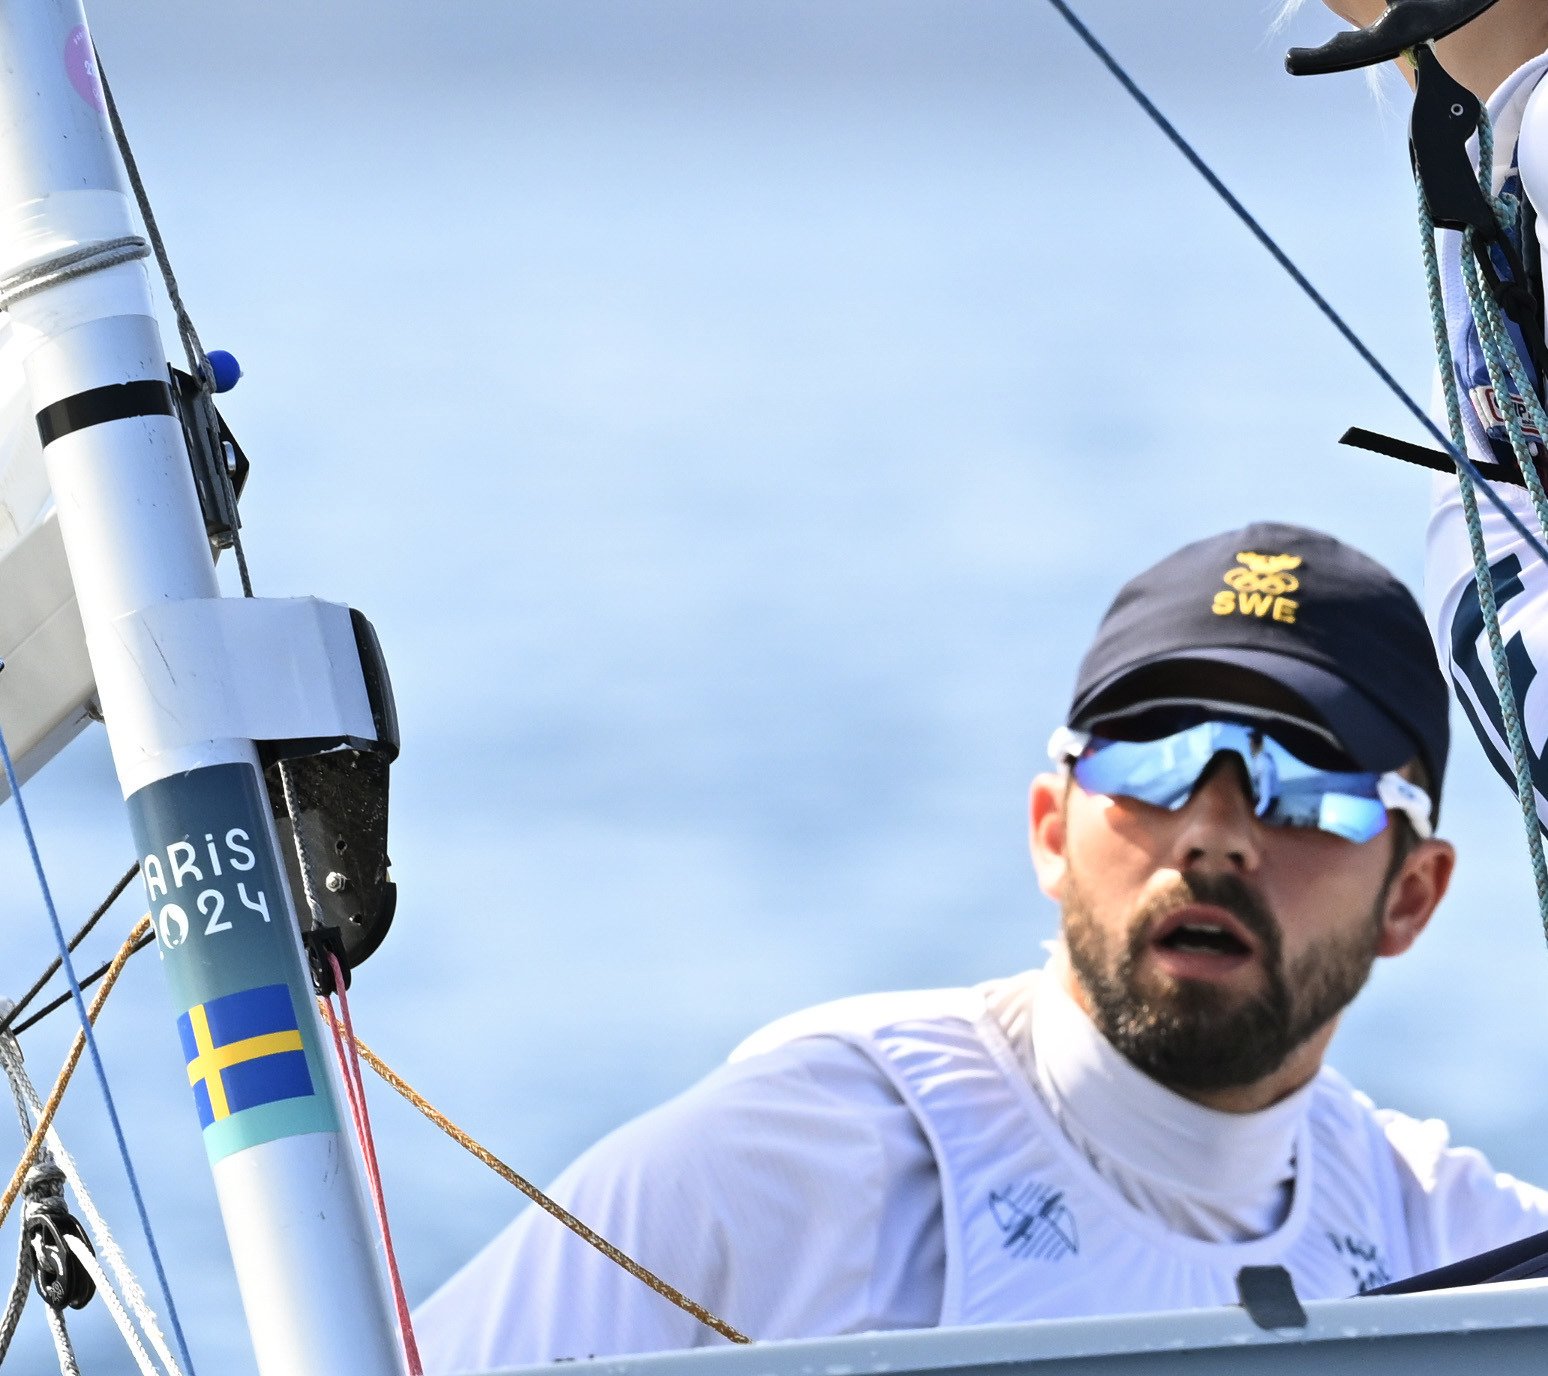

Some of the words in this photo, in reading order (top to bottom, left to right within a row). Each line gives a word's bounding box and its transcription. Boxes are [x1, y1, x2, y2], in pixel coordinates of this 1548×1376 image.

[1212, 591, 1299, 624] SWE
[140, 827, 256, 902] ARiS
[150, 882, 271, 961] 024
